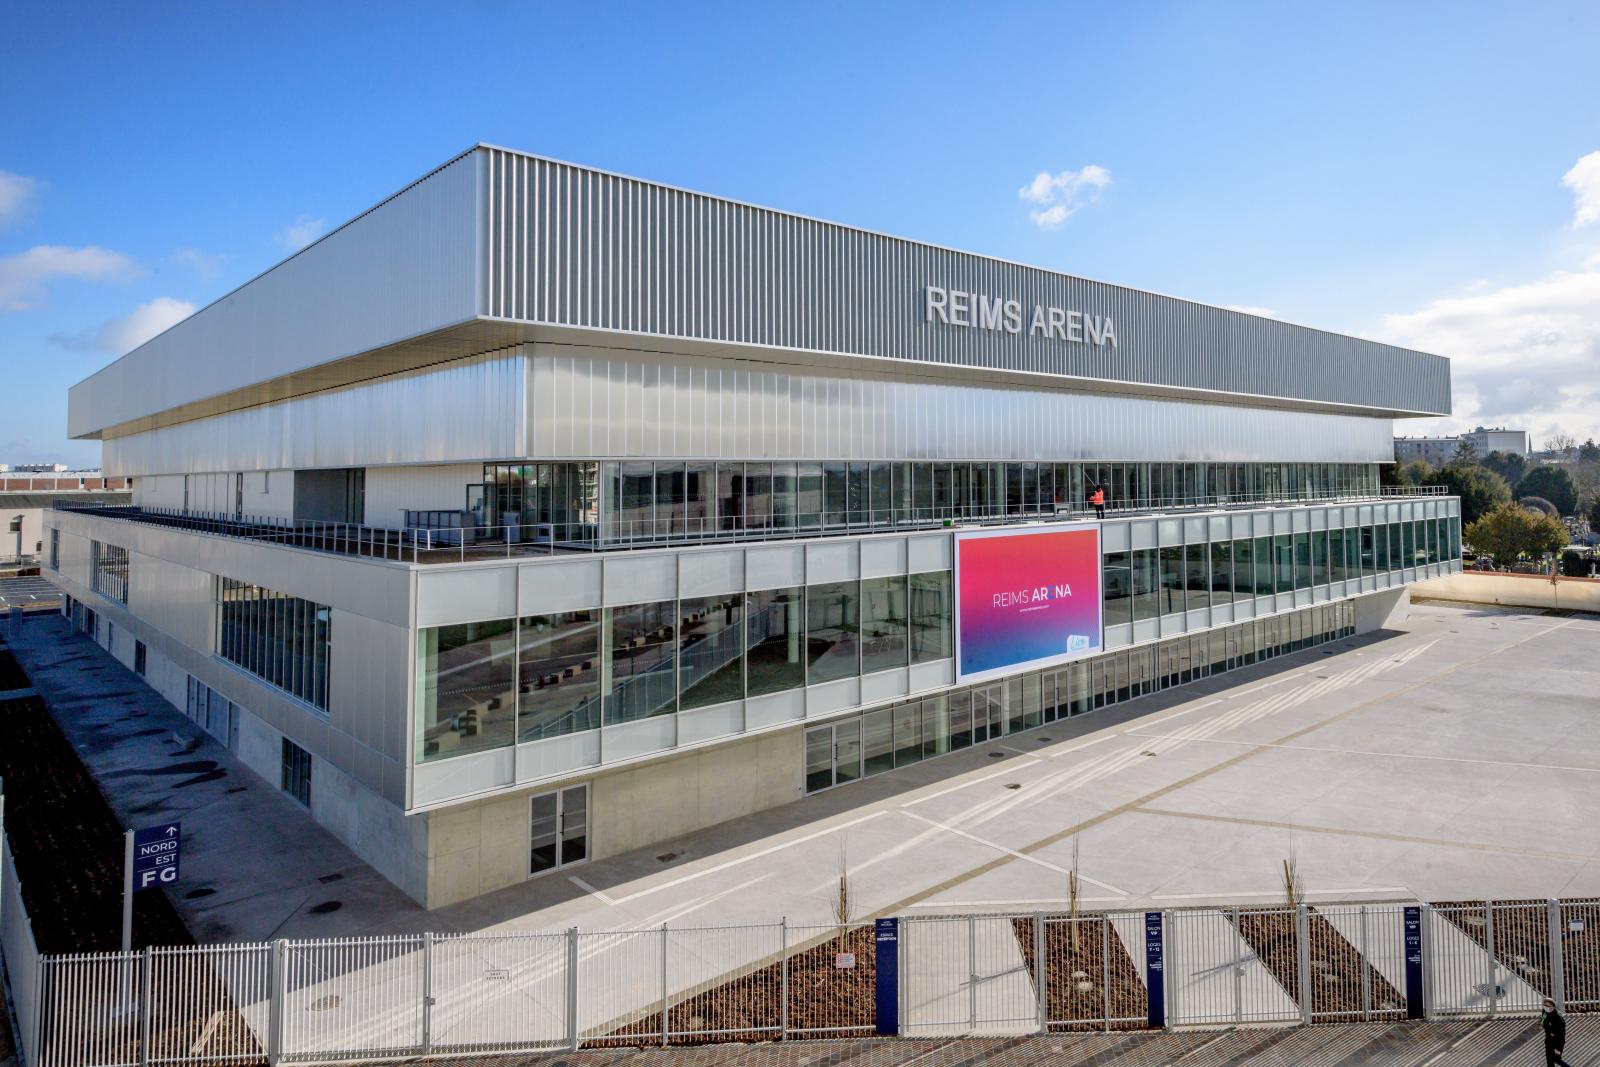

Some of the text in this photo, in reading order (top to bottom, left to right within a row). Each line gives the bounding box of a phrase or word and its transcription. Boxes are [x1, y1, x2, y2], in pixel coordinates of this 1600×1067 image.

[926, 286, 1117, 348] REIMS ARENA
[993, 589, 1029, 608] REIMS
[1031, 584, 1072, 602] ARENA
[141, 841, 177, 855] NORD
[156, 853, 176, 865] EST
